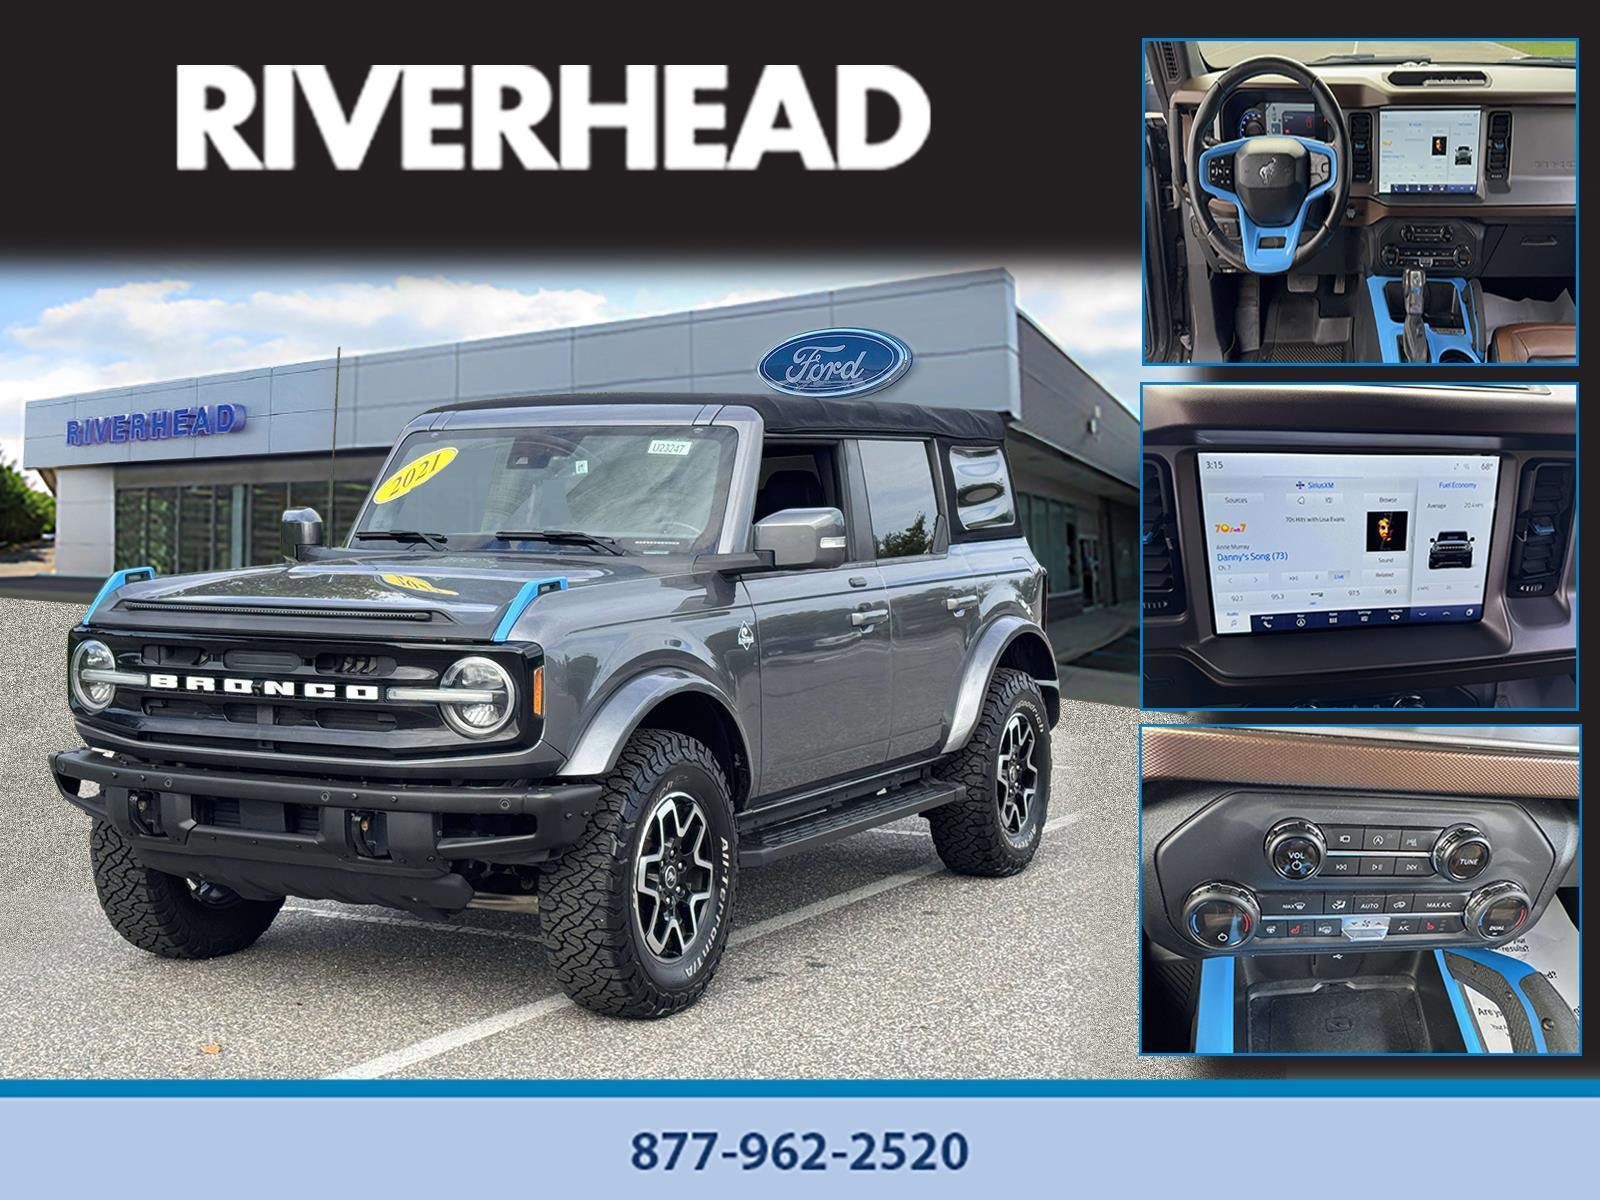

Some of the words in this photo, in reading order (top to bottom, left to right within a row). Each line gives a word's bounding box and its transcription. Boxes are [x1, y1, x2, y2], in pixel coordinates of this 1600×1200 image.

[785, 344, 867, 383] Ford
[66, 404, 242, 447] RIVERHEAD
[652, 442, 686, 454] U23247
[389, 452, 442, 498] 2021
[1206, 461, 1224, 470] 3:15
[1439, 481, 1452, 489] Fuel
[1452, 481, 1477, 490] Economy
[1225, 496, 1248, 504] Sources
[1217, 553, 1249, 562] Danny's
[1250, 552, 1271, 561] Song
[1272, 551, 1288, 560] (73)
[150, 673, 379, 700] BRONCO
[702, 836, 729, 957] All-Terrain
